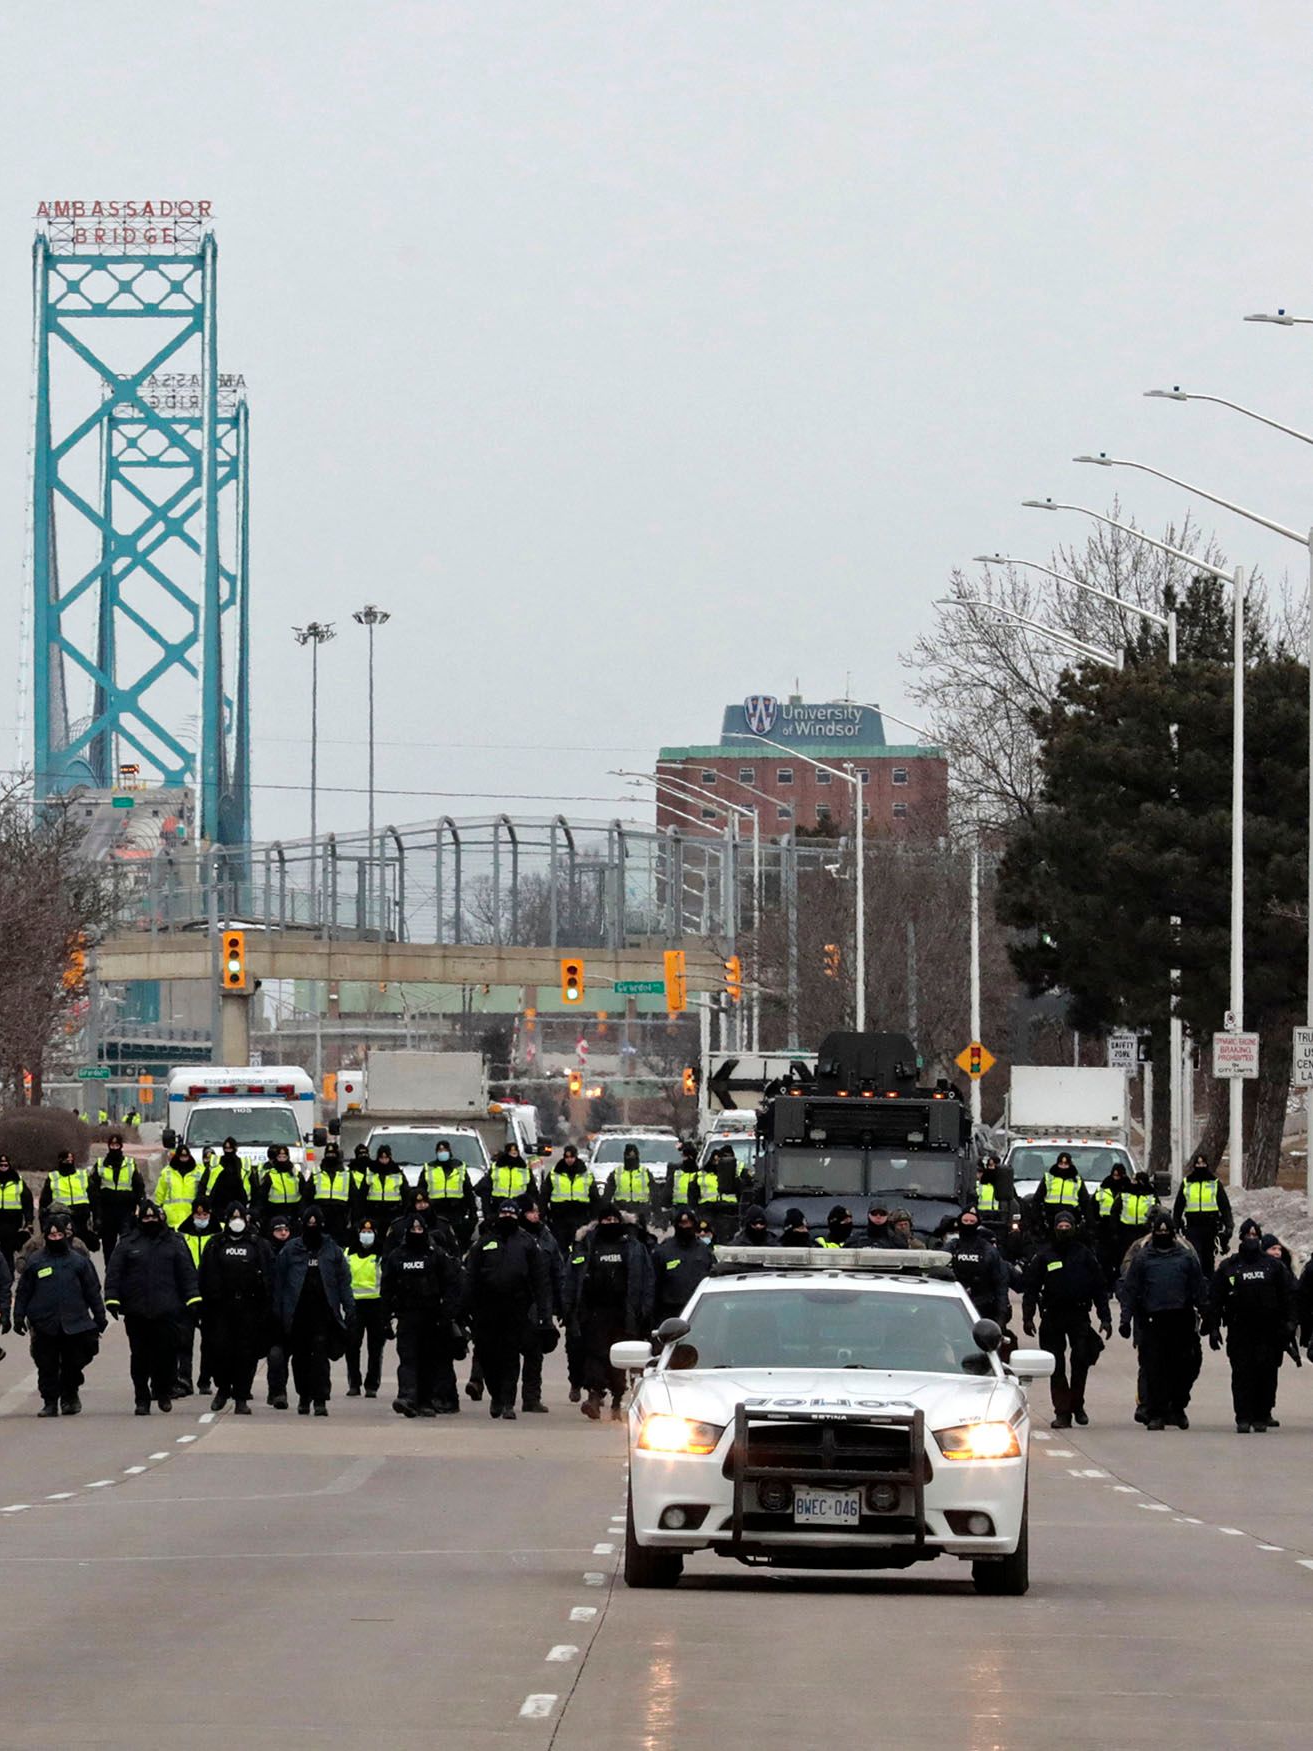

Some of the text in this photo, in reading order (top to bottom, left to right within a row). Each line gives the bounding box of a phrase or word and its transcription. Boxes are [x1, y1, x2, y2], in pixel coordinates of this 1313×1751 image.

[36, 200, 212, 217] AMBASSADOR
[75, 227, 175, 244] BRIDGE
[782, 706, 862, 723] University
[782, 721, 861, 736] of Windsor
[225, 1247, 247, 1256] POLICE
[958, 1254, 979, 1263] POLICE
[403, 1261, 424, 1269] POLICE
[1242, 1271, 1264, 1281] POLICE
[796, 1498, 858, 1517] BWEC 046
